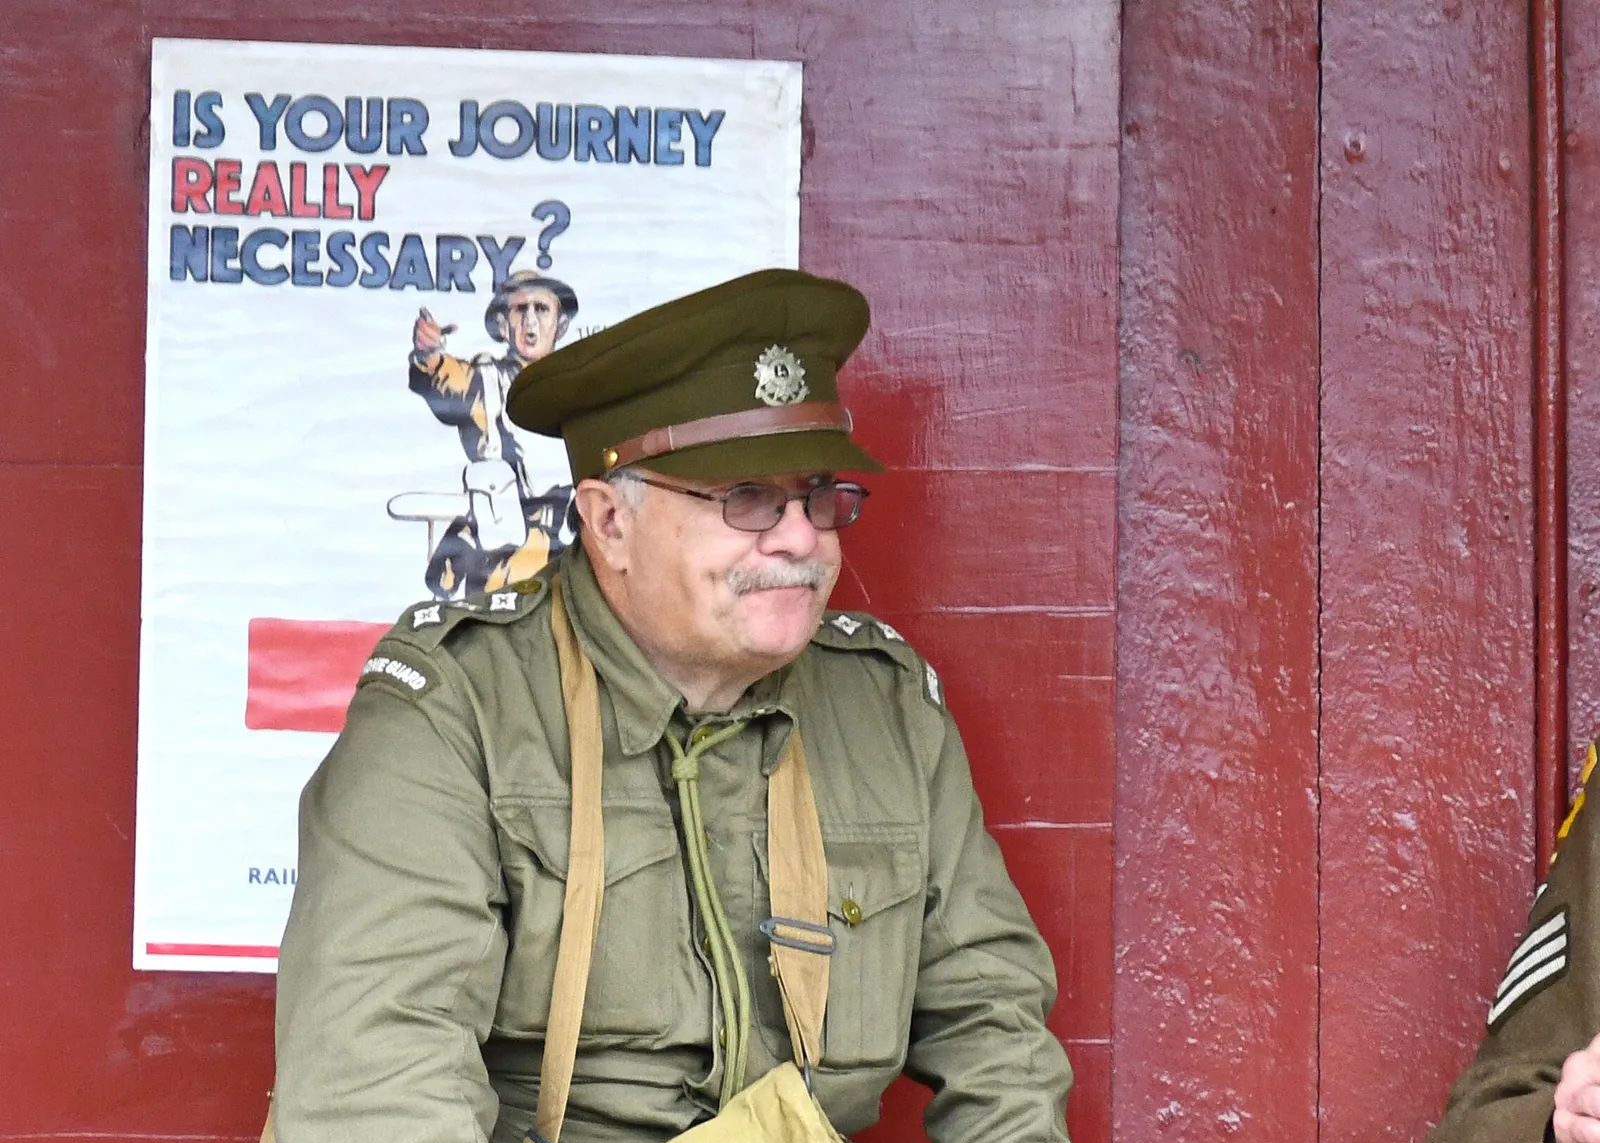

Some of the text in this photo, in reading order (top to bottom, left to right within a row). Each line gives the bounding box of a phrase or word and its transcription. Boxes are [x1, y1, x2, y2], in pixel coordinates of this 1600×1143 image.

[172, 90, 727, 168] IS YOUR JOURNEY
[170, 157, 391, 222] REALLY
[385, 660, 426, 690] GUARD
